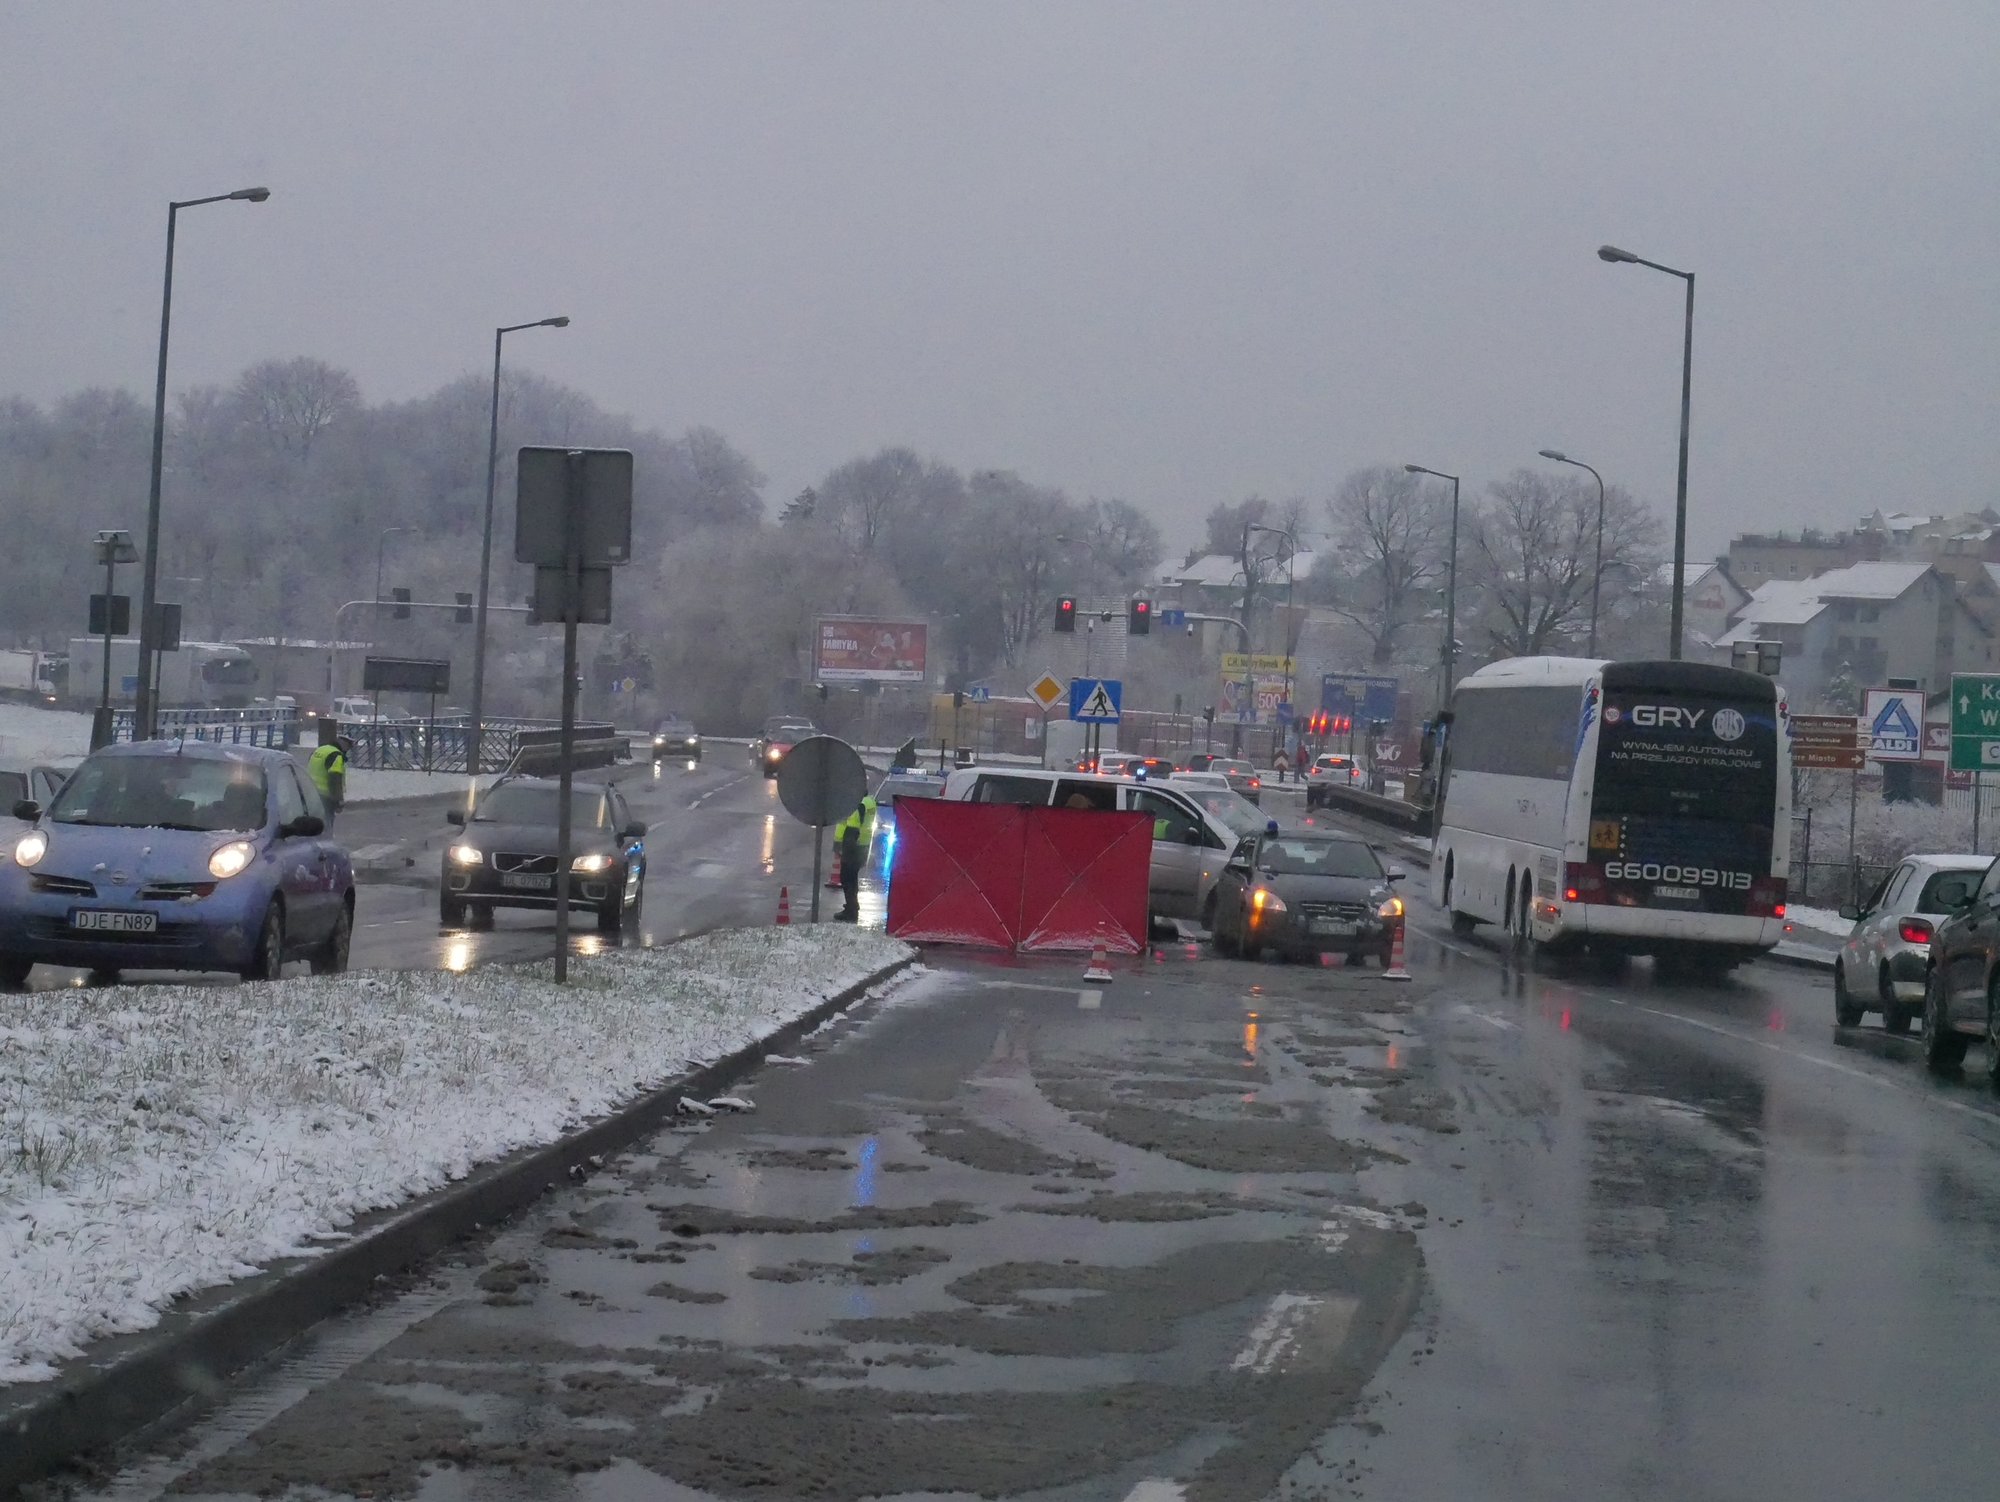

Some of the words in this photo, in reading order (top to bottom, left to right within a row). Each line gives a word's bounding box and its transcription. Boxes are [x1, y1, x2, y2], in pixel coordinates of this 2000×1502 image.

[1258, 692, 1280, 710] 500
[1632, 705, 1705, 729] GRY
[1622, 741, 1684, 752] WYNAJEM
[1688, 745, 1754, 758] AUTOKARU
[1873, 739, 1913, 751] ALDI
[1611, 751, 1629, 761] NA
[1631, 752, 1700, 765] PRZEJAZDY
[1703, 759, 1763, 769] KRAJOWE
[1808, 754, 1837, 762] Miasto
[1605, 862, 1752, 889] 660099113
[79, 912, 108, 929] DJE
[113, 914, 153, 930] FN89
